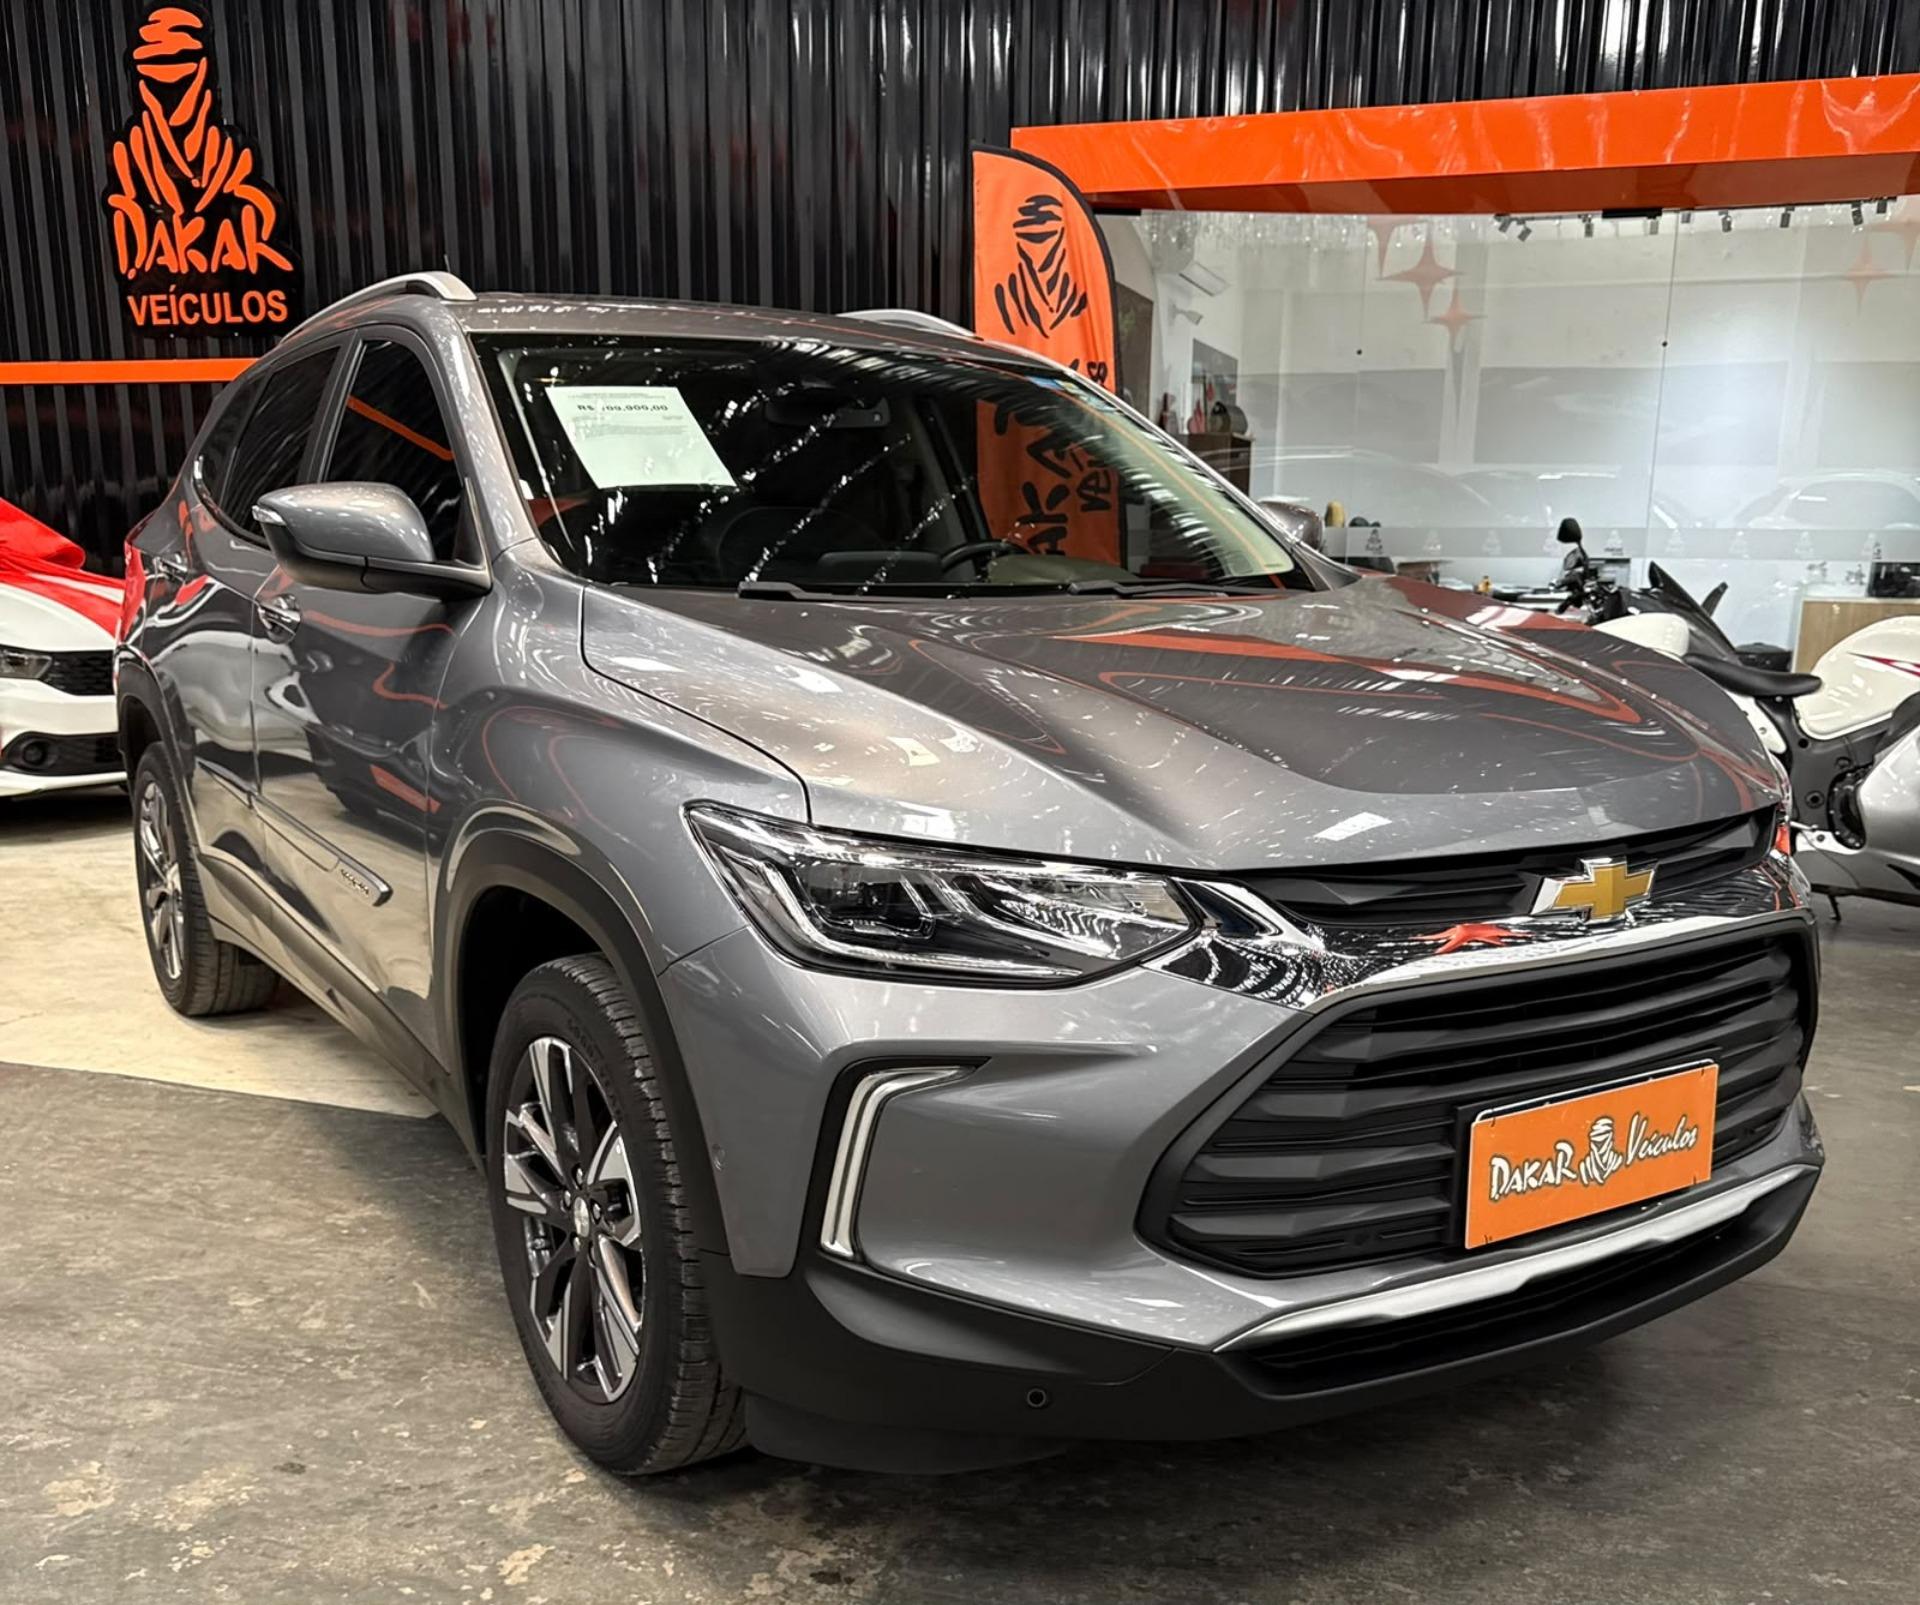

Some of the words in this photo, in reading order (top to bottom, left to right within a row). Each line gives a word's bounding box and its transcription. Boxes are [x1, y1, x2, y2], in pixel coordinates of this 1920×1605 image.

[108, 192, 294, 280] DAKAR
[127, 284, 288, 326] VEÍCULOS
[1490, 1142, 1578, 1201] DAKAR
[1625, 1112, 1699, 1167] Veículos
